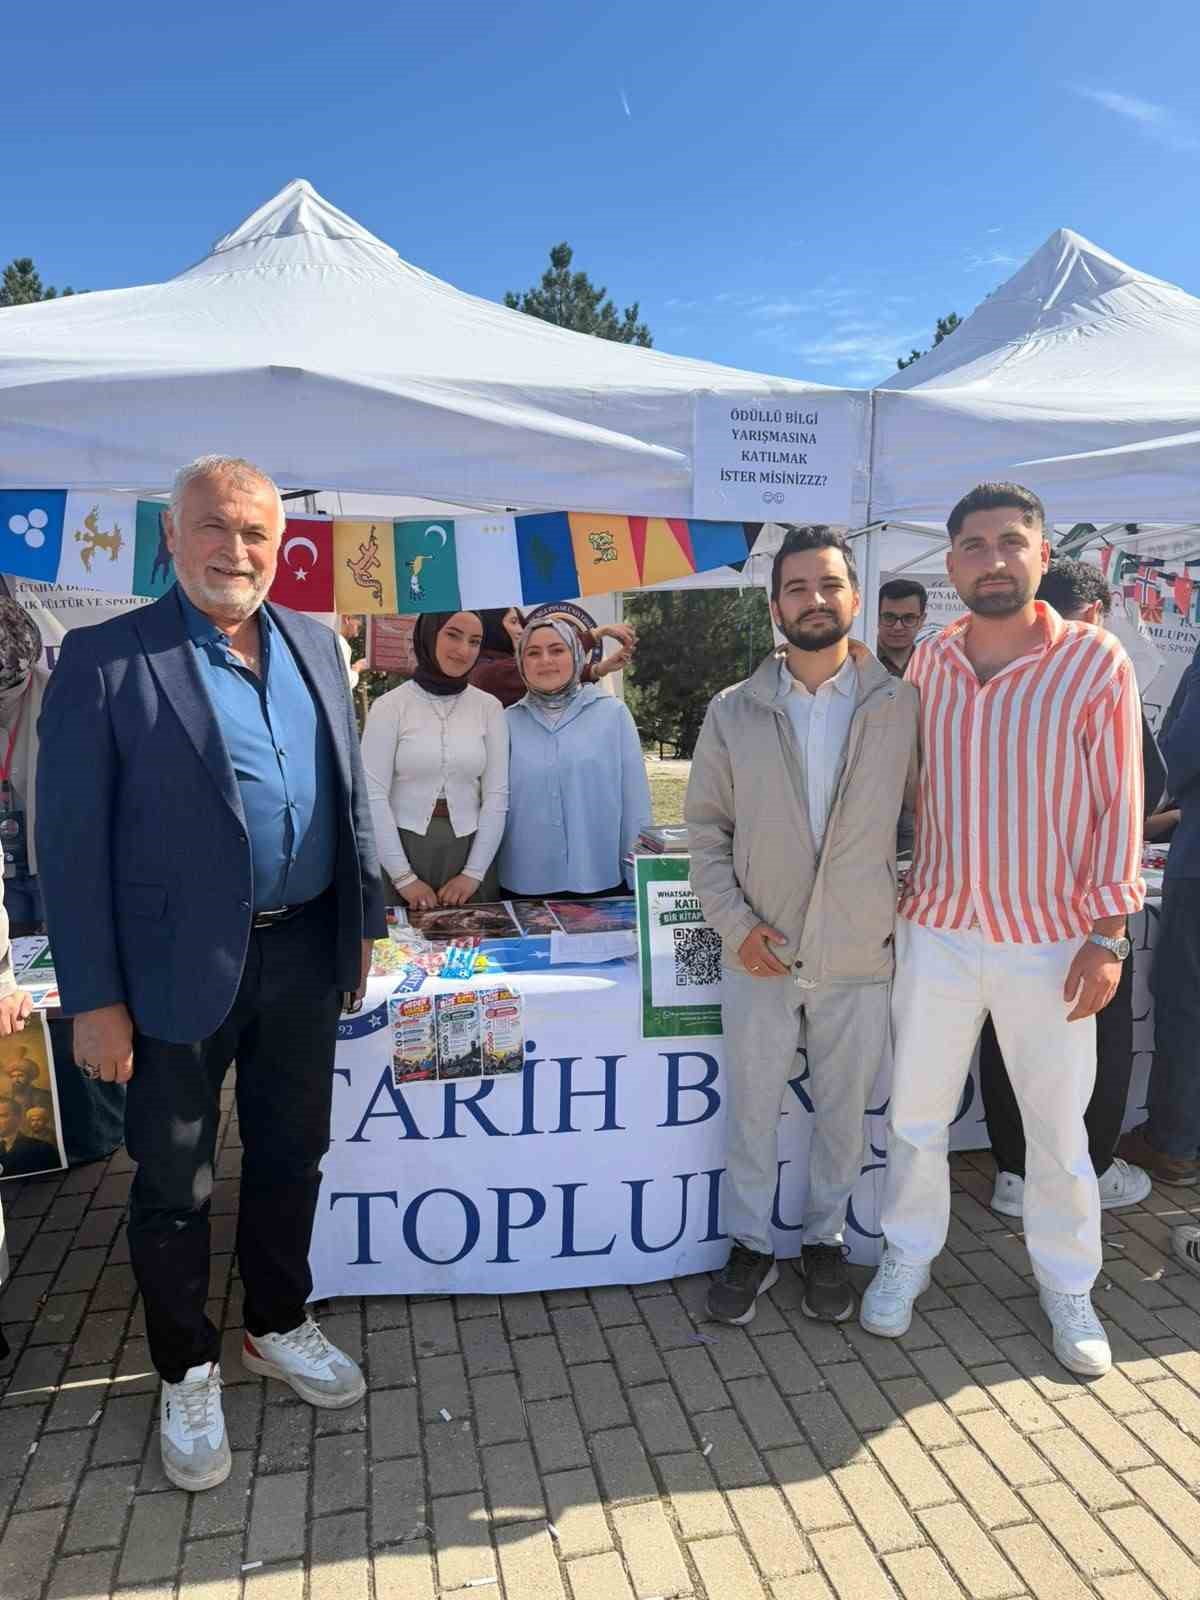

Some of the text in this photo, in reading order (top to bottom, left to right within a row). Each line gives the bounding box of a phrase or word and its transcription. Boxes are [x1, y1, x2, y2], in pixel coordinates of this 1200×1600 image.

[730, 408, 818, 425] ÖDÜLLÜ BİLGİ
[731, 429, 817, 445] YARIŞMASINA
[741, 450, 808, 465] KATILMAK
[720, 467, 828, 487] İSTER MİSİNİZZZ?
[87, 597, 103, 607] VE
[105, 597, 138, 607] SPOR
[338, 1025, 353, 1036] 92
